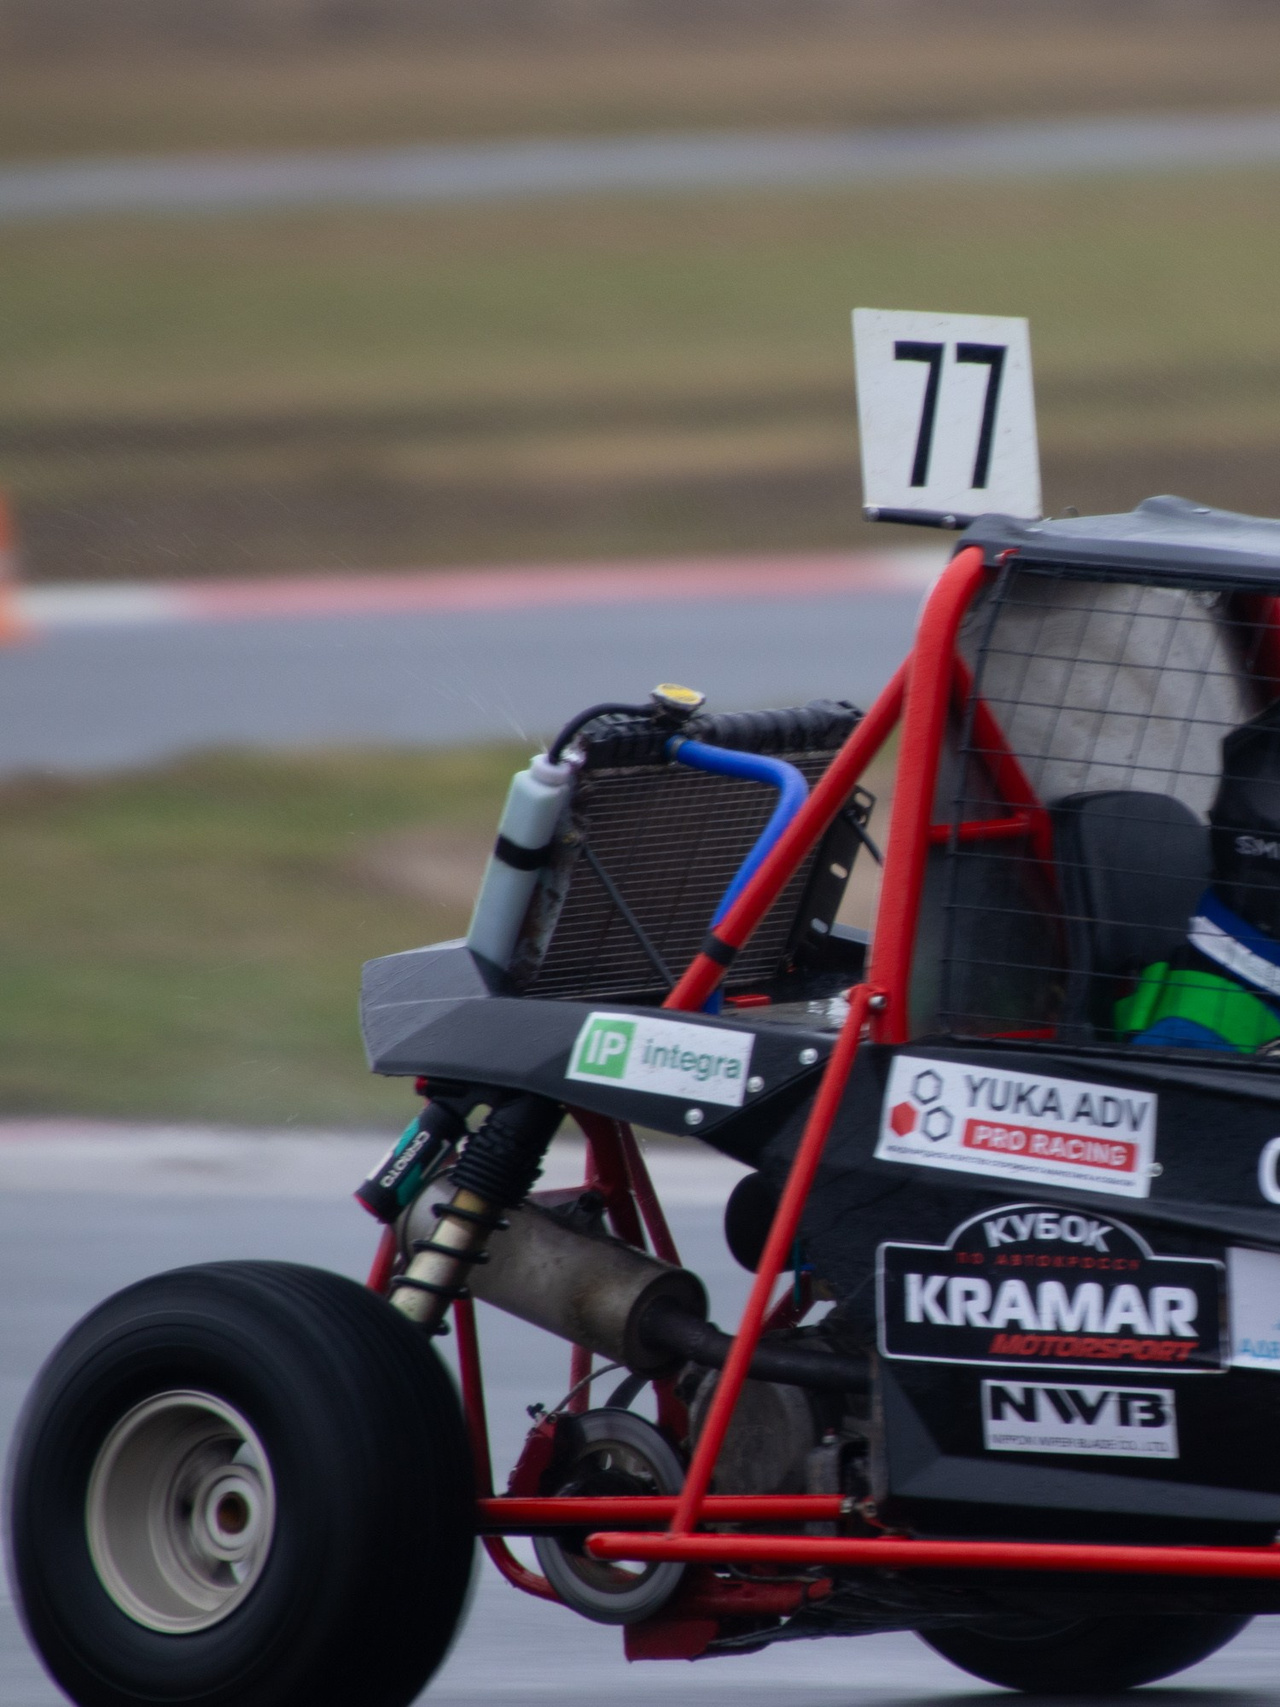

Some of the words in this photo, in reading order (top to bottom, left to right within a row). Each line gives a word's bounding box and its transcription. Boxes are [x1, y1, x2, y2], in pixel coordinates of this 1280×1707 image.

[893, 340, 1008, 489] 77
[586, 1029, 628, 1066] IP
[642, 1039, 742, 1082] integra
[964, 1074, 1065, 1121] YUKA
[1071, 1092, 1149, 1132] ADV
[971, 1124, 1026, 1151] PRO
[1029, 1133, 1128, 1167] RACING
[983, 1212, 1115, 1253] КУБОК
[903, 1272, 1200, 1338] KRAMAR
[988, 1333, 1200, 1362] MOTORSPORT
[989, 1385, 1172, 1429] NWB
